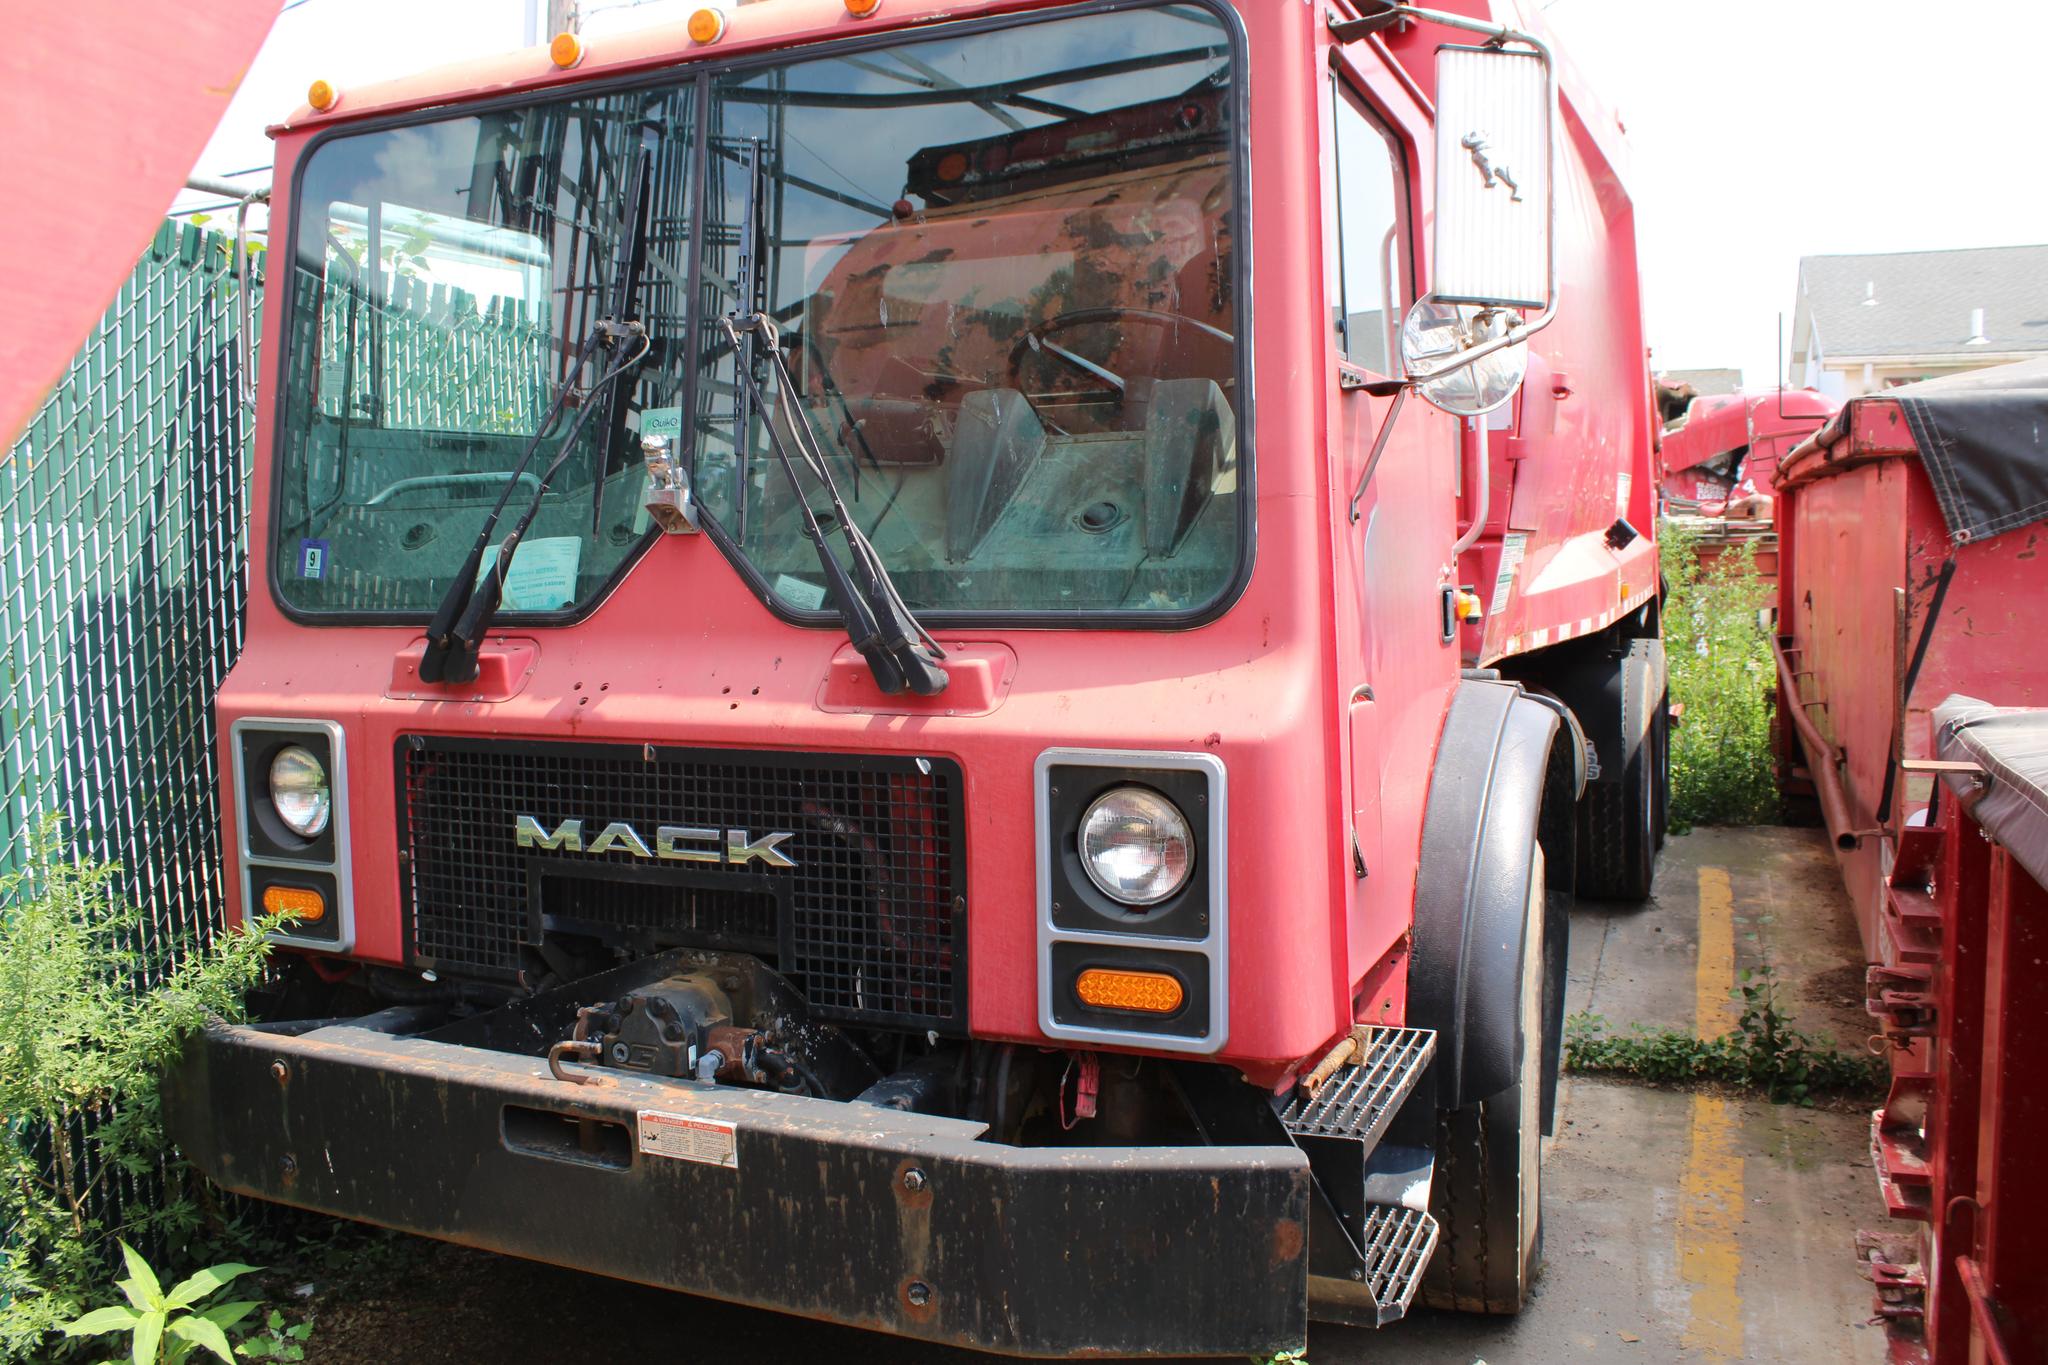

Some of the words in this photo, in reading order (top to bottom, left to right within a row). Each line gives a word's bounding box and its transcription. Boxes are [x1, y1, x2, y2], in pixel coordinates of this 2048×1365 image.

[309, 551, 316, 567] 9
[516, 815, 799, 867] MACK
[658, 1117, 684, 1127] DANGER
